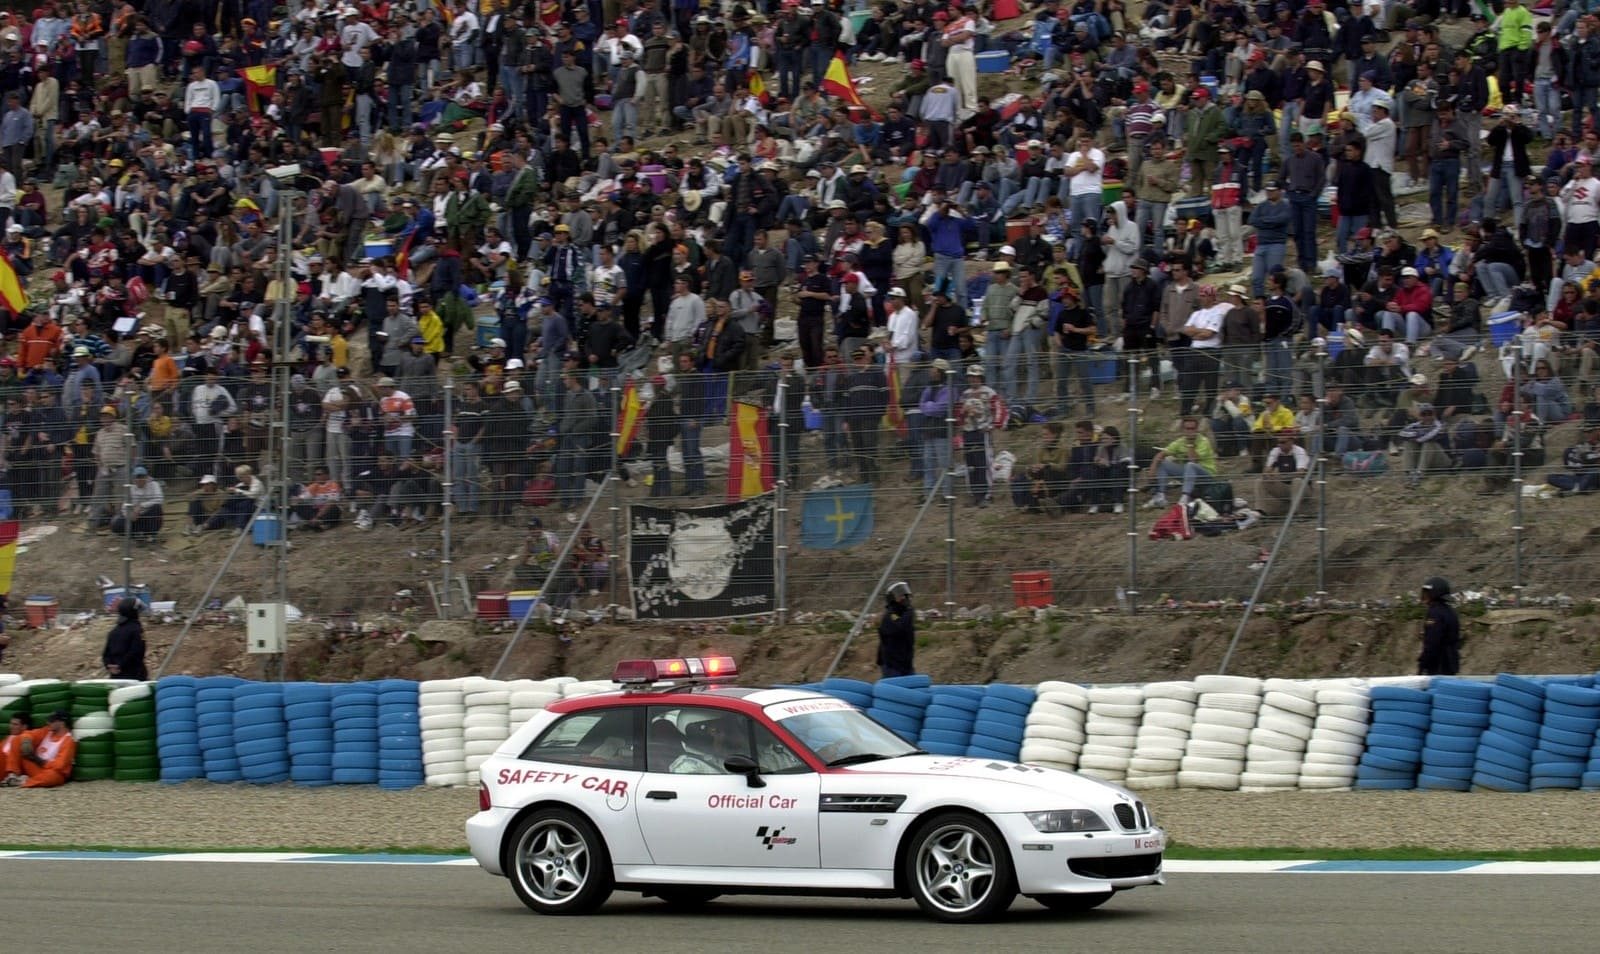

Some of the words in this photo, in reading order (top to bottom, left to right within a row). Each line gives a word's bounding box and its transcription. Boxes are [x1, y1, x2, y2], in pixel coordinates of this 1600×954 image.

[497, 769, 579, 785] SAFETY
[581, 777, 628, 797] CAR
[708, 795, 764, 808] Official
[768, 795, 798, 808] Car
[1134, 839, 1141, 849] M
